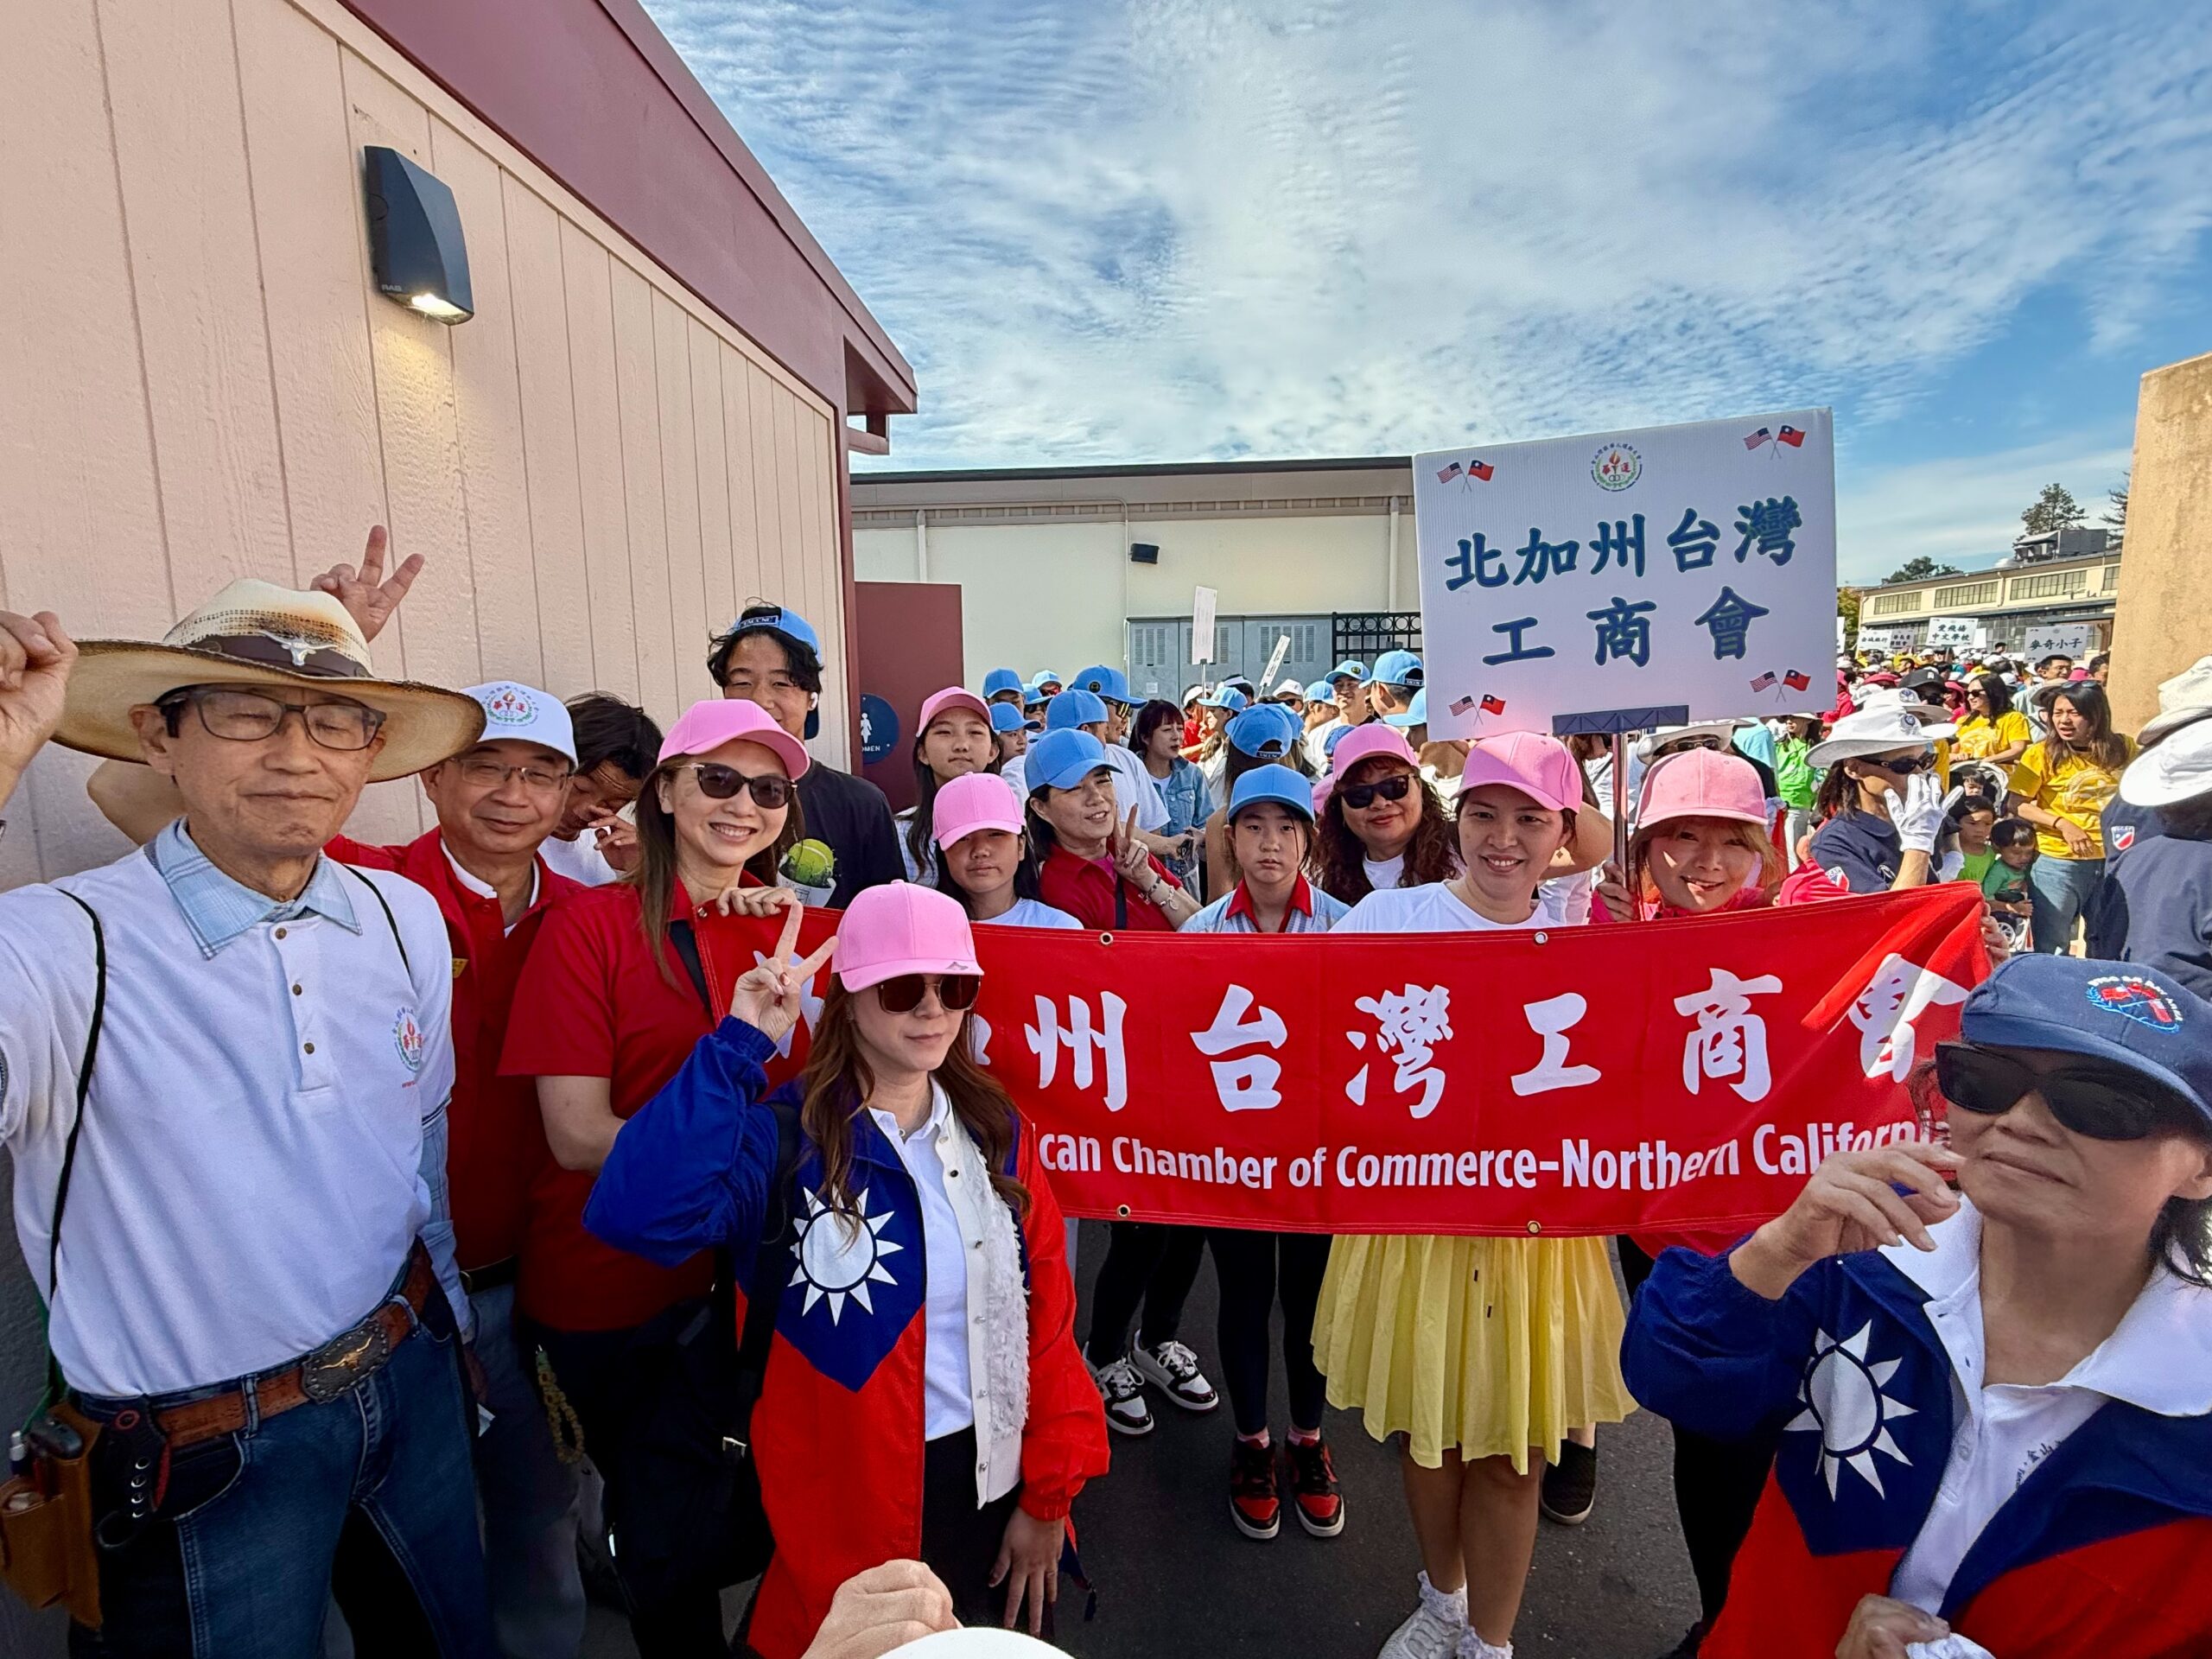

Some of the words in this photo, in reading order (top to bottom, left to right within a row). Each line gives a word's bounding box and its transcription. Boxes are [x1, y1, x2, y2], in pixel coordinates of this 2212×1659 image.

[1445, 495, 1802, 591] 北加州台灣
[1483, 586, 1770, 667] 工商會
[971, 950, 1968, 1120] 州台灣工商會
[1039, 1133, 1101, 1170] can
[1112, 1136, 1277, 1189] Chamber
[1288, 1147, 1328, 1187] of
